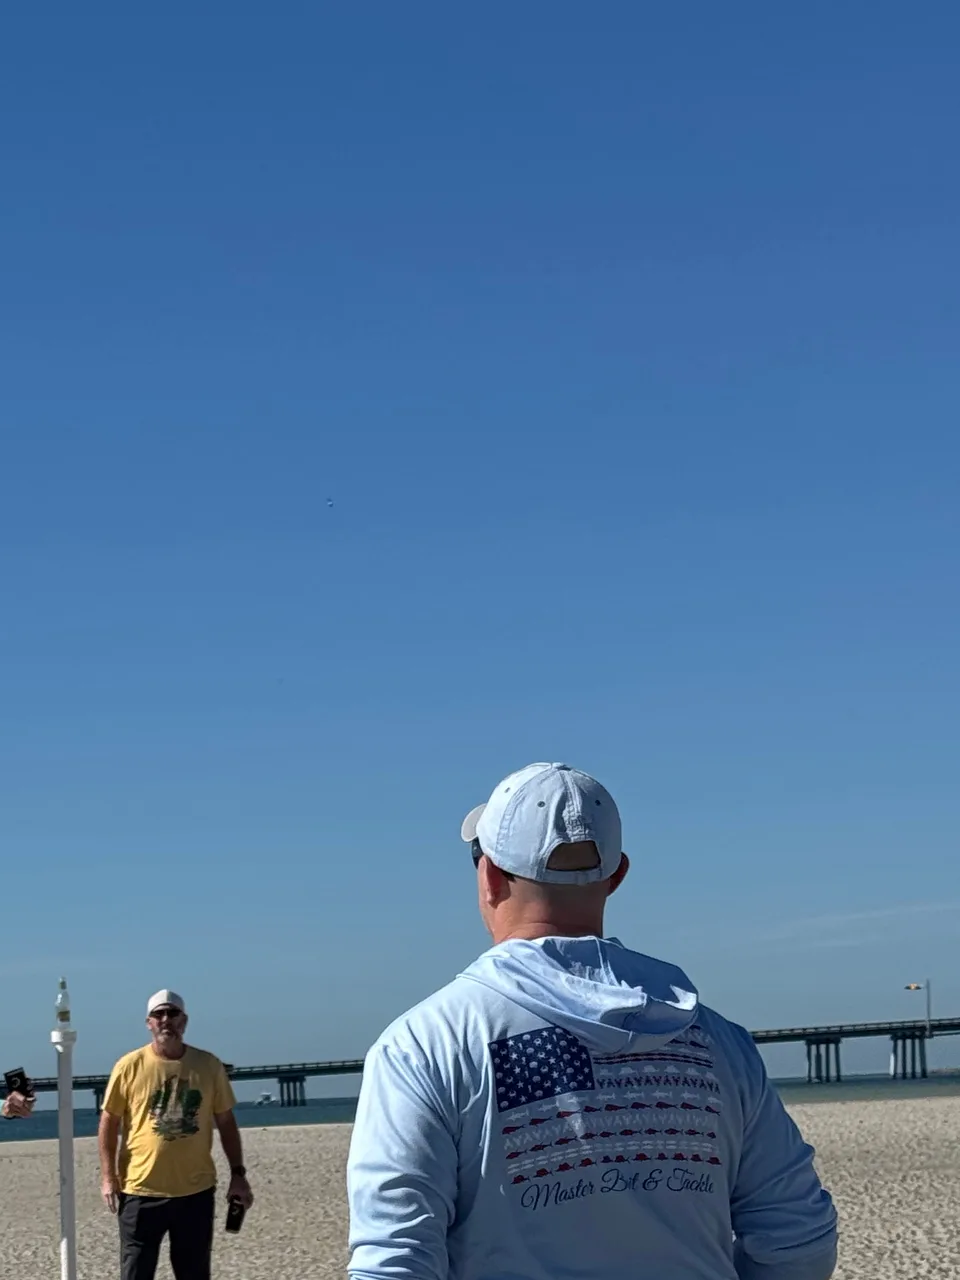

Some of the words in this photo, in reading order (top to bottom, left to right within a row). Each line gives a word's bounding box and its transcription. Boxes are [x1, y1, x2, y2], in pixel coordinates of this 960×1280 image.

[521, 1179, 594, 1211] Master
[642, 1168, 663, 1191] &
[666, 1167, 715, 1194] Tackle
